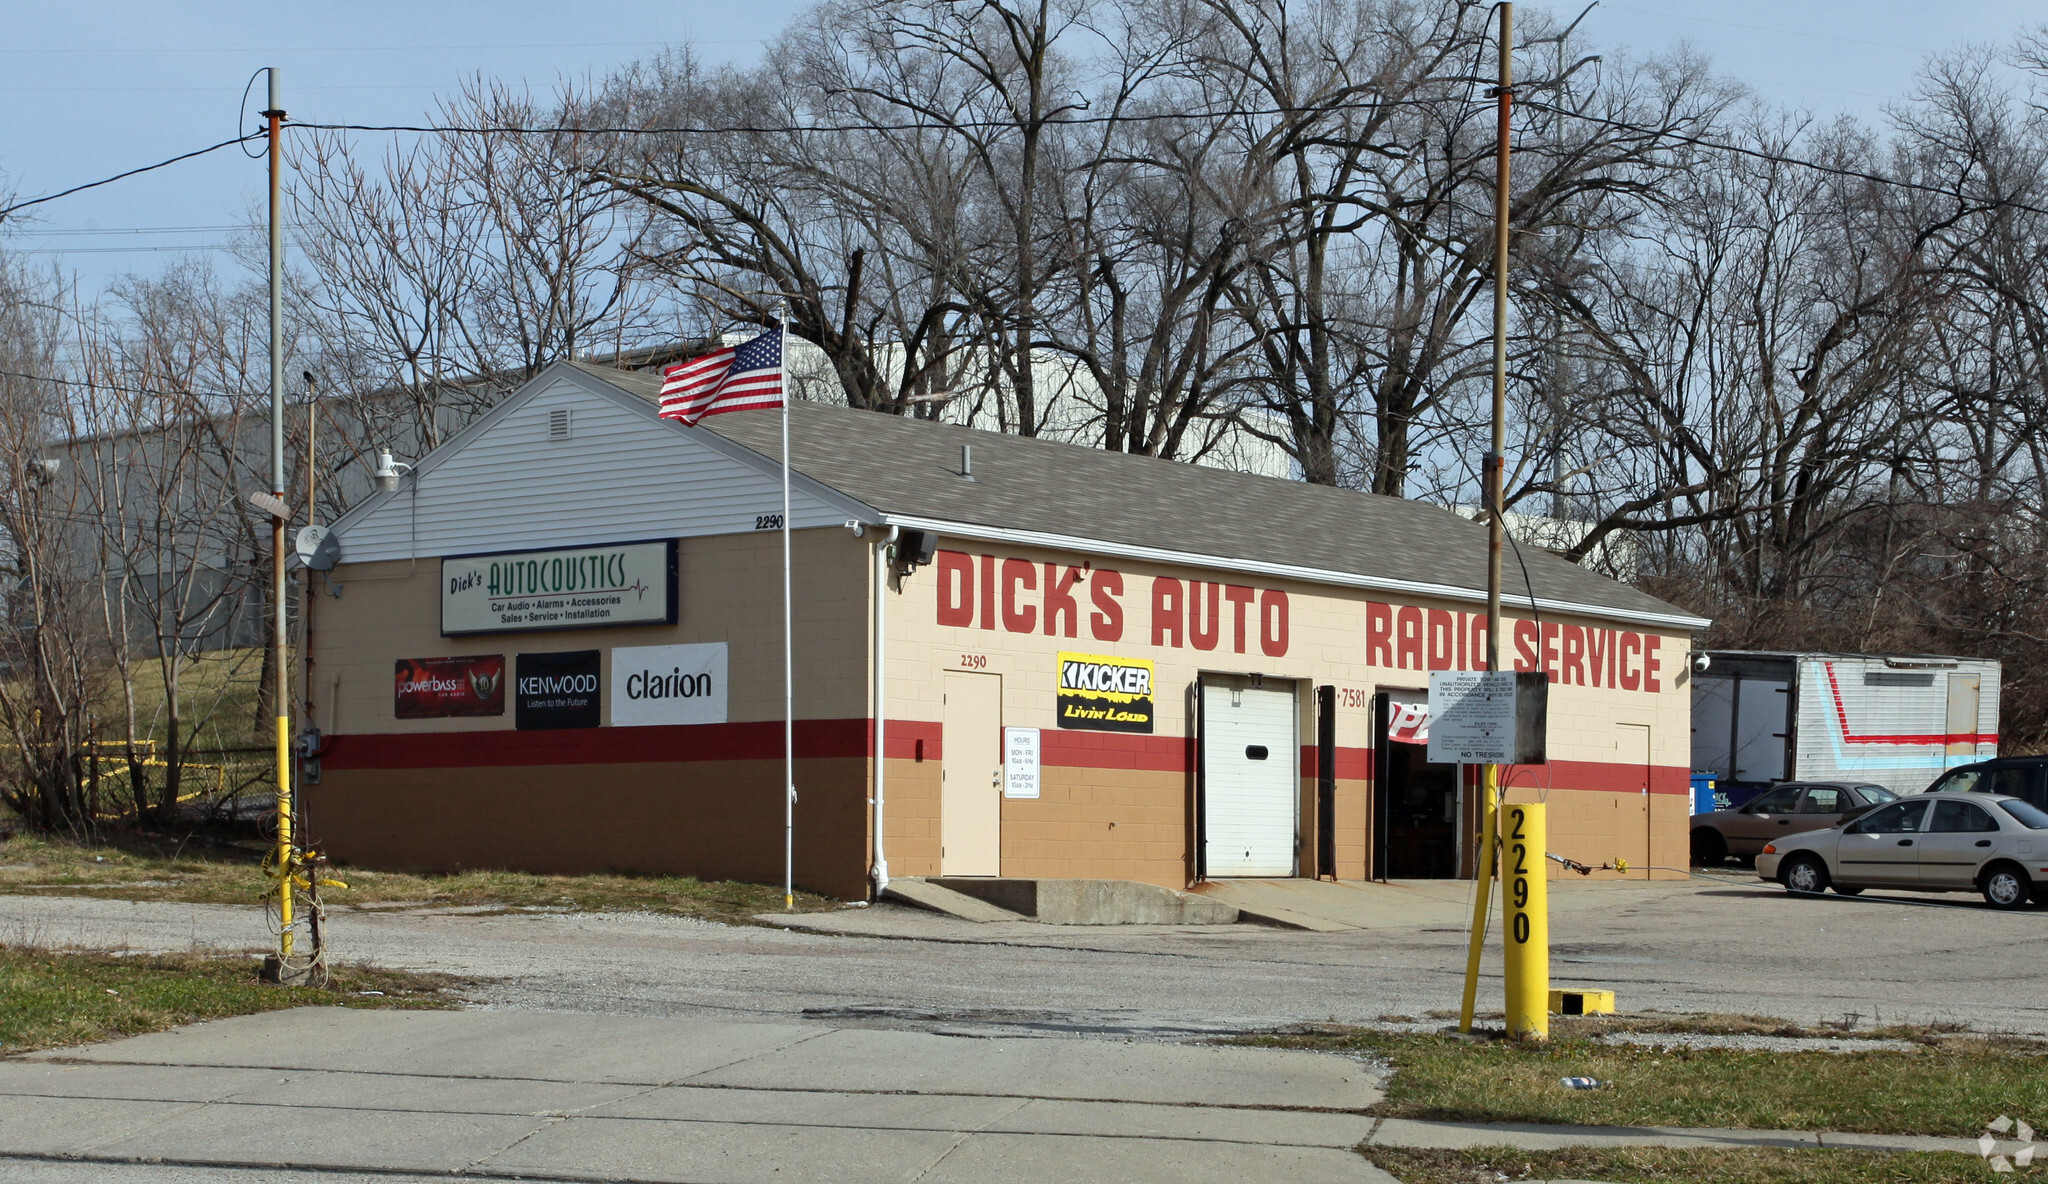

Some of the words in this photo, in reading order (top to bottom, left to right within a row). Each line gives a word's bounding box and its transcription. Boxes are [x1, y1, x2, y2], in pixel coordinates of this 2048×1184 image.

[755, 514, 784, 529] 2290
[450, 570, 482, 595] Dick's
[487, 553, 626, 595] AUTOCOUSTICS
[491, 602, 505, 612] Car
[507, 600, 530, 611] Audio
[536, 599, 564, 609] Alarms
[571, 596, 621, 607] Accessories
[501, 612, 522, 623] Sales
[529, 610, 558, 621] Service
[565, 608, 610, 619] Installation
[937, 549, 1124, 642] DICK'S
[1151, 576, 1289, 658] AUTO
[1513, 619, 1661, 693] SERVICE
[961, 654, 987, 670] 2290
[519, 674, 597, 695] KENWOOD
[626, 666, 711, 700] clarion
[1077, 663, 1150, 694] KICKER
[527, 699, 546, 708] Listen
[548, 699, 554, 707] to
[556, 698, 566, 707] the
[568, 698, 587, 707] Future
[1511, 809, 1530, 944] 2290
